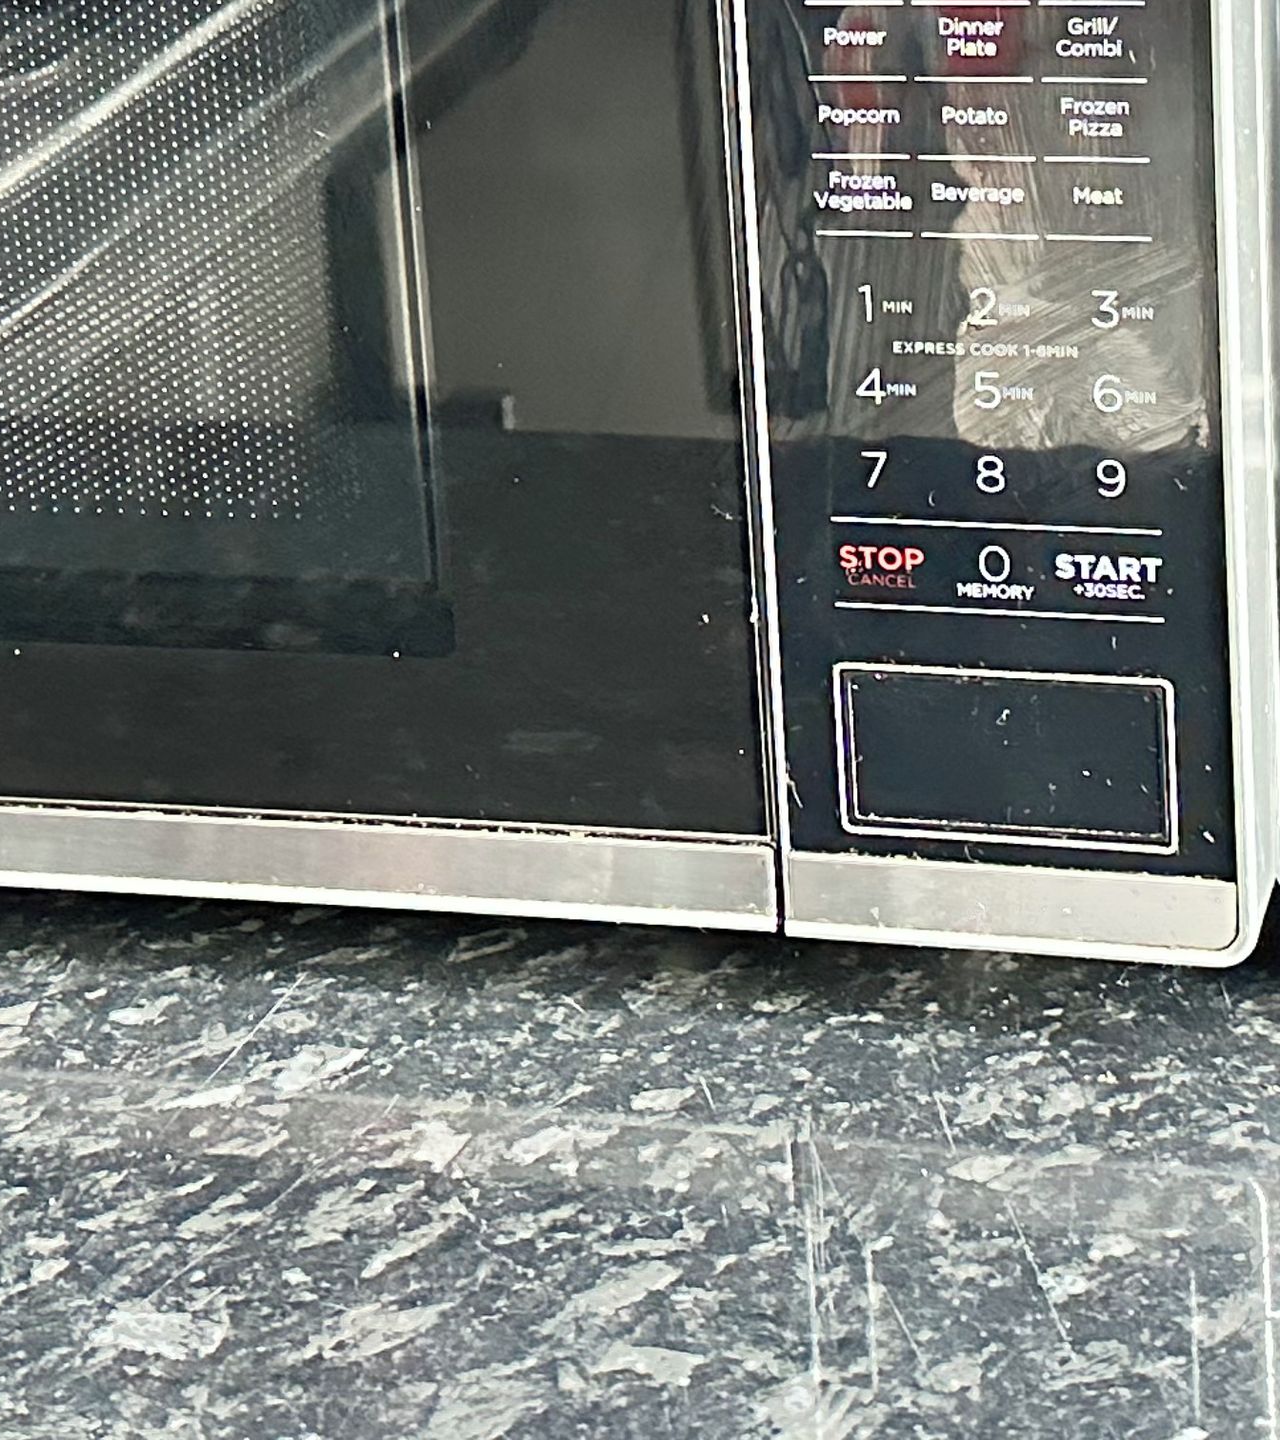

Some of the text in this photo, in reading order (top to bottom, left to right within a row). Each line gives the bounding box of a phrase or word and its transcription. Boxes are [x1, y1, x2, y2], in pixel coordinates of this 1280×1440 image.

[939, 18, 1004, 36] Dinner
[1068, 18, 1118, 35] Grill/
[824, 29, 887, 46] Power
[947, 39, 997, 56] Plate
[1056, 40, 1121, 58] Combi
[819, 106, 900, 126] Popcorn
[942, 107, 1008, 125] Potato
[1061, 97, 1129, 116] Frozen
[1069, 119, 1123, 136] Pizza
[829, 172, 896, 190] Frozen
[814, 191, 912, 212] Vegetable
[931, 183, 1024, 204] Beverage
[1073, 187, 1123, 205] Meat
[858, 284, 913, 322] 1 MIN
[969, 287, 1029, 326] 2 MIN
[1091, 290, 1154, 328] 3 MIN
[893, 341, 965, 355] EXPRESS
[970, 343, 1018, 357] COOK
[856, 368, 916, 405] 4 MIN
[973, 372, 1033, 409] 5 MIN
[1092, 374, 1156, 412] 6 MIN
[861, 451, 888, 488] 7
[976, 455, 1005, 493] 8
[1096, 459, 1126, 498] 9
[839, 545, 925, 570] STOP
[1055, 554, 1162, 582] START
[848, 572, 916, 589] CANCEL
[957, 582, 1034, 600] MEMORY
